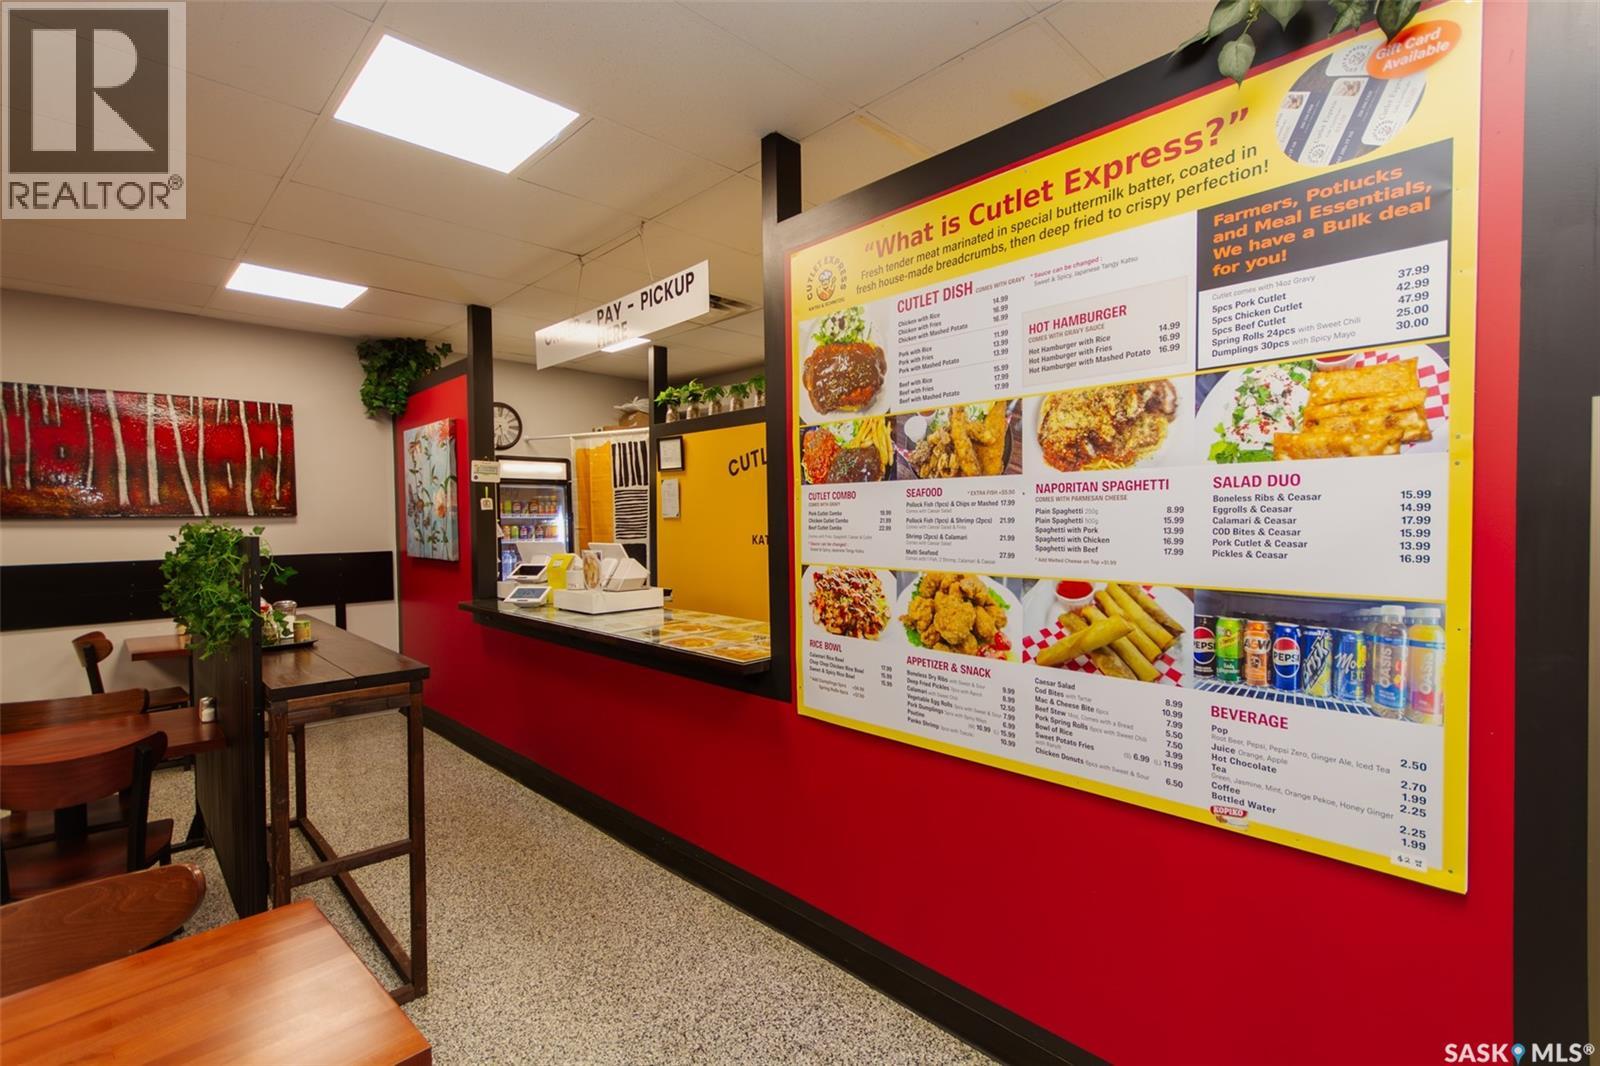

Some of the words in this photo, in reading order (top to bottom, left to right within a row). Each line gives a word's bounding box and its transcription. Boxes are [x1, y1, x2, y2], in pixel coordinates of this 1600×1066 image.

[1376, 42, 1402, 60] Gift
[1404, 28, 1442, 49] Card
[1383, 40, 1450, 72] Available
[865, 222, 933, 256] “What
[941, 215, 960, 236] is
[968, 180, 1053, 225] Cutlet
[1064, 108, 1248, 194] Express?”
[1214, 198, 1297, 226] Farmers,
[1307, 168, 1403, 201] Potlucks
[860, 264, 884, 279] Fresh
[885, 256, 914, 272] tender
[916, 246, 939, 262] meat
[942, 228, 994, 253] marinated
[997, 225, 1007, 236] in
[1010, 209, 1052, 233] special
[1056, 187, 1124, 218] buttermilk
[1128, 173, 1174, 195] batter,
[1179, 149, 1235, 178] coated
[1242, 145, 1256, 159] in
[1213, 225, 1248, 243] and
[1255, 210, 1301, 233] Meal
[1310, 182, 1432, 219] Essentials,
[856, 280, 876, 294] fresh
[878, 264, 933, 287] house-made
[936, 243, 1007, 270] breadcrumbs,
[1009, 233, 1035, 248] then
[1038, 223, 1070, 239] deep
[1073, 210, 1103, 229] fried
[1108, 207, 1121, 219] to
[1126, 192, 1170, 213] crispy
[1176, 160, 1268, 202] perfection!
[1214, 244, 1241, 260] We
[1249, 232, 1295, 251] have
[1303, 228, 1315, 239] a
[1323, 213, 1372, 234] Bulk
[1379, 196, 1430, 220] deal
[1212, 262, 1239, 276] for
[1245, 250, 1286, 271] you!
[1398, 265, 1430, 278] 37.99
[1396, 278, 1430, 291] 42.99
[597, 301, 622, 325] PAY
[640, 272, 694, 311] PICKUP
[897, 290, 939, 312] CUTLET
[943, 281, 972, 301] DISH
[1212, 304, 1232, 313] 5pcs
[1235, 298, 1255, 308] Pork
[1257, 293, 1286, 304] Cutlet
[1398, 291, 1429, 304] 47.99
[1212, 315, 1232, 325] 5pcs
[1234, 308, 1270, 320] Chicken
[1273, 302, 1302, 313] Cutlet
[1396, 304, 1429, 318] 25.00
[1028, 320, 1050, 334] HOT
[1053, 305, 1126, 328] HAMBURGER
[1212, 326, 1232, 336] 5pcs
[1234, 320, 1255, 331] Beef
[1257, 316, 1285, 327] Cutlet
[1396, 317, 1429, 330] 30.00
[1159, 322, 1180, 332] 14.99
[1159, 333, 1180, 343] 16.99
[1211, 336, 1240, 346] Spring
[1242, 331, 1264, 341] Rolls
[1266, 327, 1295, 337] 24pcs
[1040, 342, 1077, 352] Hamburger
[1159, 344, 1180, 353] 16.99
[1211, 345, 1258, 357] Dumplings
[1260, 340, 1289, 350] 30pcs
[1041, 361, 1076, 371] Hamburger
[1078, 357, 1094, 365] with
[1095, 352, 1123, 362] Mashed
[1125, 349, 1151, 358] Potato
[728, 448, 767, 476] CUTL
[1036, 481, 1098, 493] NAPORITAN
[1102, 478, 1168, 491] SPAGHETTI
[1213, 475, 1262, 488] SALAD
[1267, 473, 1300, 486] DUO
[808, 491, 830, 500] CUTLET
[831, 490, 856, 500] COMBO
[906, 487, 942, 497] SEAFOOD
[1254, 493, 1274, 501] Ribs
[1276, 493, 1284, 501] &
[1287, 492, 1321, 501] Ceasar
[1401, 490, 1432, 499] 15.99
[1212, 505, 1247, 515] Eggrolls
[1259, 504, 1292, 513] Ceasar
[1400, 503, 1431, 512] 14.99
[1402, 516, 1431, 525] 17.99
[1212, 527, 1230, 535] COD
[1232, 527, 1255, 535] Bites
[1257, 527, 1265, 535] &
[1268, 527, 1301, 536] Ceasar
[1400, 529, 1431, 538] 15.99
[1400, 542, 1430, 550] 13.99
[1400, 554, 1430, 564] 16.99
[809, 639, 822, 649] RICE
[824, 641, 842, 652] BOWL
[906, 656, 948, 670] APPETIZER
[950, 662, 957, 672] &
[960, 664, 990, 678] SNACK
[1380, 647, 1392, 688] OASIS
[1034, 677, 1056, 686] Caesar
[1057, 681, 1075, 690] Salad
[1034, 713, 1048, 722] Pork
[1050, 716, 1071, 728] Spring
[1072, 720, 1088, 730] Rolls
[1211, 705, 1288, 729] BEVERAGE
[1211, 724, 1228, 735] Pop
[1035, 732, 1054, 741] Sweet
[1055, 736, 1077, 746] Potato
[1078, 740, 1094, 750] Fries
[1210, 743, 1235, 754] Juice
[1035, 747, 1060, 758] Chicken
[1060, 752, 1084, 764] Donuts
[1211, 753, 1226, 763] Hot
[1229, 757, 1277, 773] Chocolate
[1211, 763, 1226, 773] Tea
[1401, 759, 1427, 772] 2.50
[1211, 781, 1240, 794] Coffee
[1401, 780, 1426, 793] 2.70
[1211, 792, 1244, 806] Bottled
[1247, 800, 1276, 813] Water
[1402, 793, 1426, 805] 1.99
[1213, 806, 1244, 816] KOPIKO
[1400, 805, 1426, 818] 2.25
[1400, 826, 1426, 838] 2.25
[1402, 838, 1426, 850] 1.99
